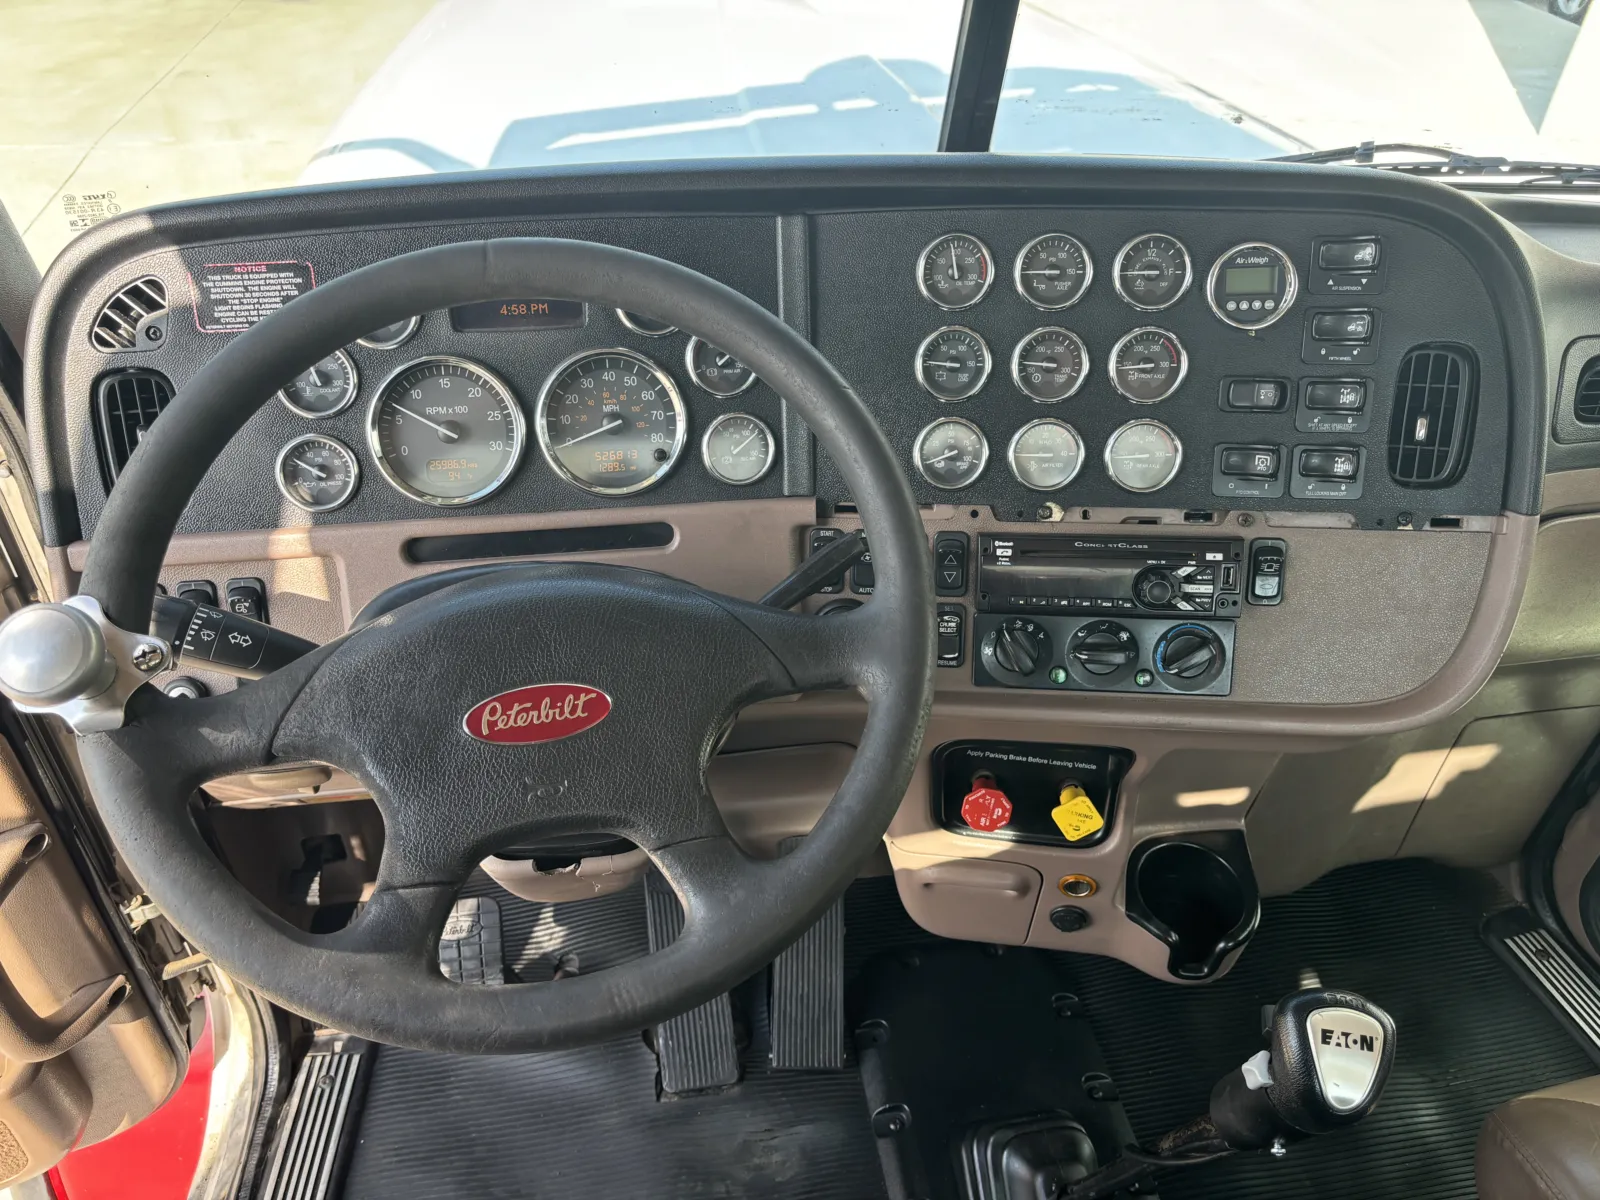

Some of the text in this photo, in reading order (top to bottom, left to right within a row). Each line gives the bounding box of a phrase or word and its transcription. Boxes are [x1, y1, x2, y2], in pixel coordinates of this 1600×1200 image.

[500, 303, 548, 315] 4:58 PM
[602, 372, 615, 380] 40
[439, 379, 450, 388] 15
[581, 379, 593, 388] 30
[624, 377, 637, 386] 50
[410, 390, 422, 399] 10
[468, 388, 482, 397] 20
[642, 391, 654, 400] 60
[566, 395, 578, 404] 20
[426, 407, 446, 415] RPM
[487, 411, 500, 420] 25
[651, 411, 664, 420] 70
[396, 416, 402, 424] 5
[560, 415, 570, 424] 10
[651, 433, 663, 442] 80
[489, 441, 502, 450] 30
[401, 447, 408, 455] 0
[448, 472, 460, 480] 94
[481, 693, 597, 735] Peterbilt
[985, 752, 1007, 760] Parking
[1049, 759, 1072, 767] Leaving
[1321, 1028, 1374, 1052] EATON
